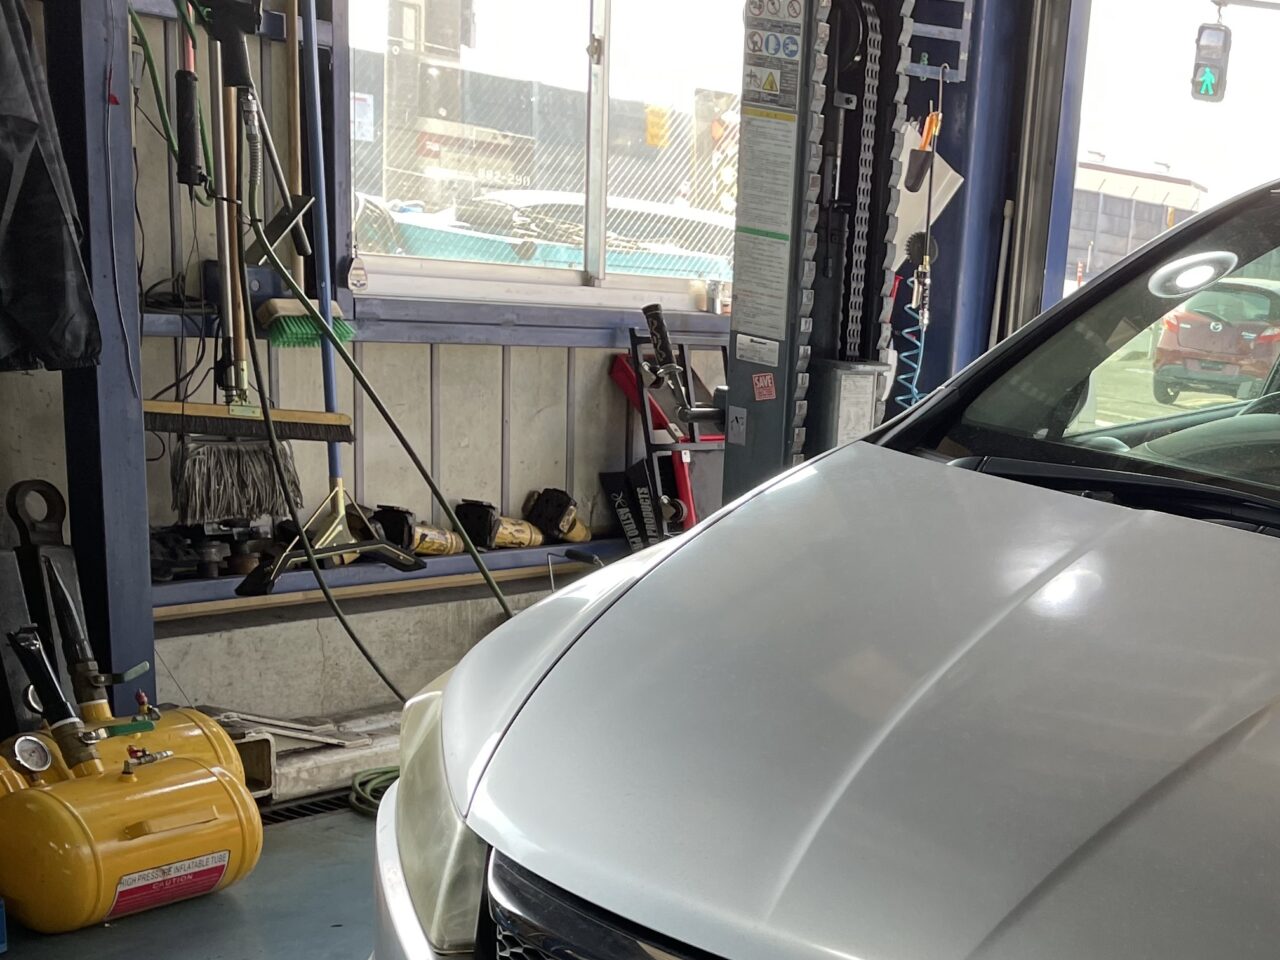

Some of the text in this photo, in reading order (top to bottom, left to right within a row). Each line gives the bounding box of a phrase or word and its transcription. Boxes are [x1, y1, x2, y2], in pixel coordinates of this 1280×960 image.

[754, 375, 772, 388] SAVE
[615, 506, 640, 537] ASTRO
[636, 486, 658, 536] PRODUCTS
[173, 858, 211, 874] INFLATABLE
[211, 853, 227, 865] TUBE
[152, 874, 194, 889] CAUTION
